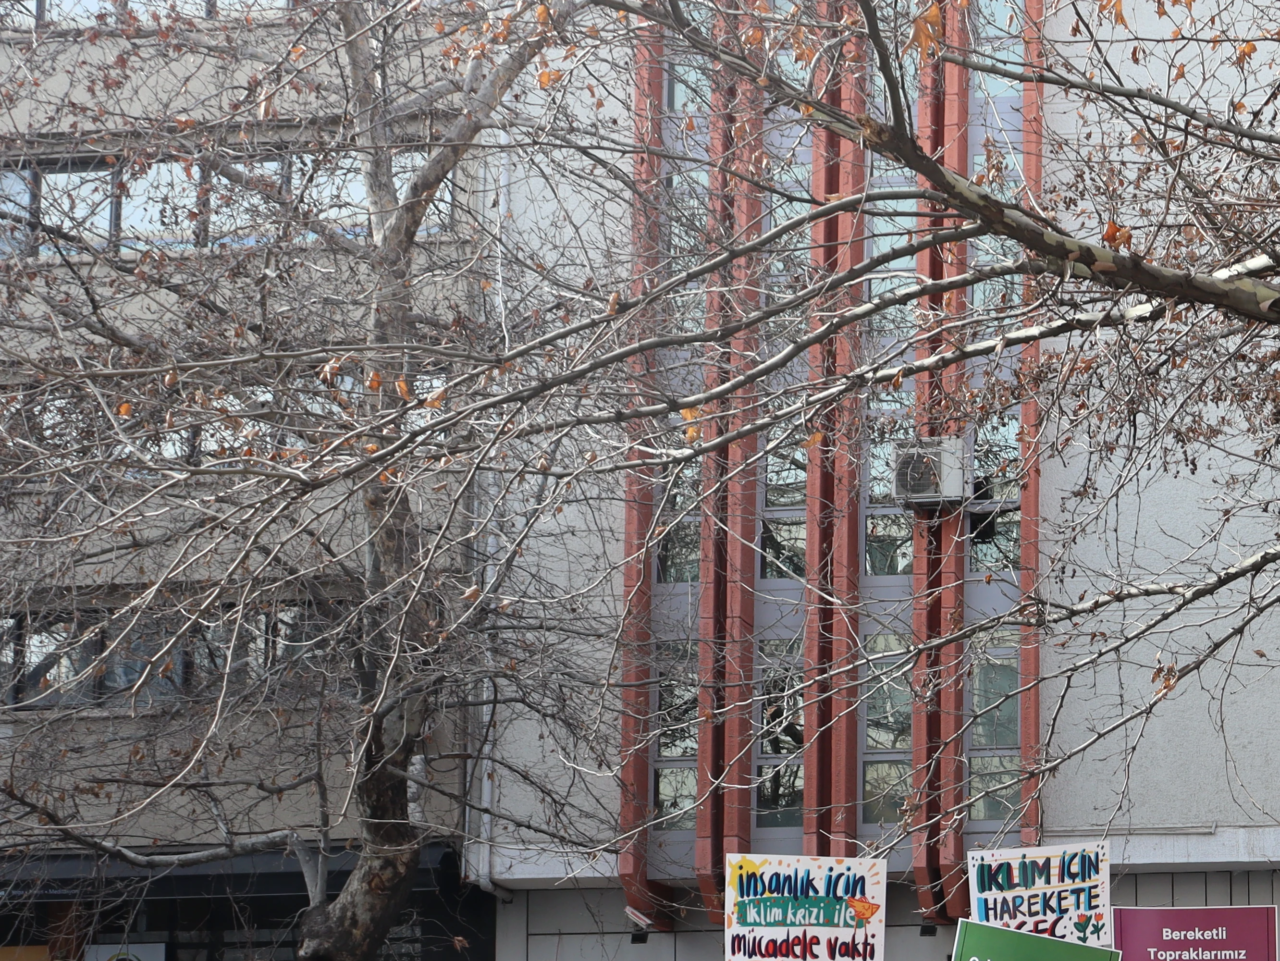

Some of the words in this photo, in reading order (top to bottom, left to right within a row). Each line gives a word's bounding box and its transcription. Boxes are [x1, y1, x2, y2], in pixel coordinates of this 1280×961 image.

[823, 865, 866, 902] için
[976, 853, 1051, 894] İKLİM
[1057, 848, 1100, 884] İÇİN
[744, 899, 783, 925] iklim
[833, 902, 857, 928] ile
[976, 884, 1100, 922] HAREKETE
[731, 928, 821, 961] mücadele
[1162, 926, 1227, 941] Bereketli
